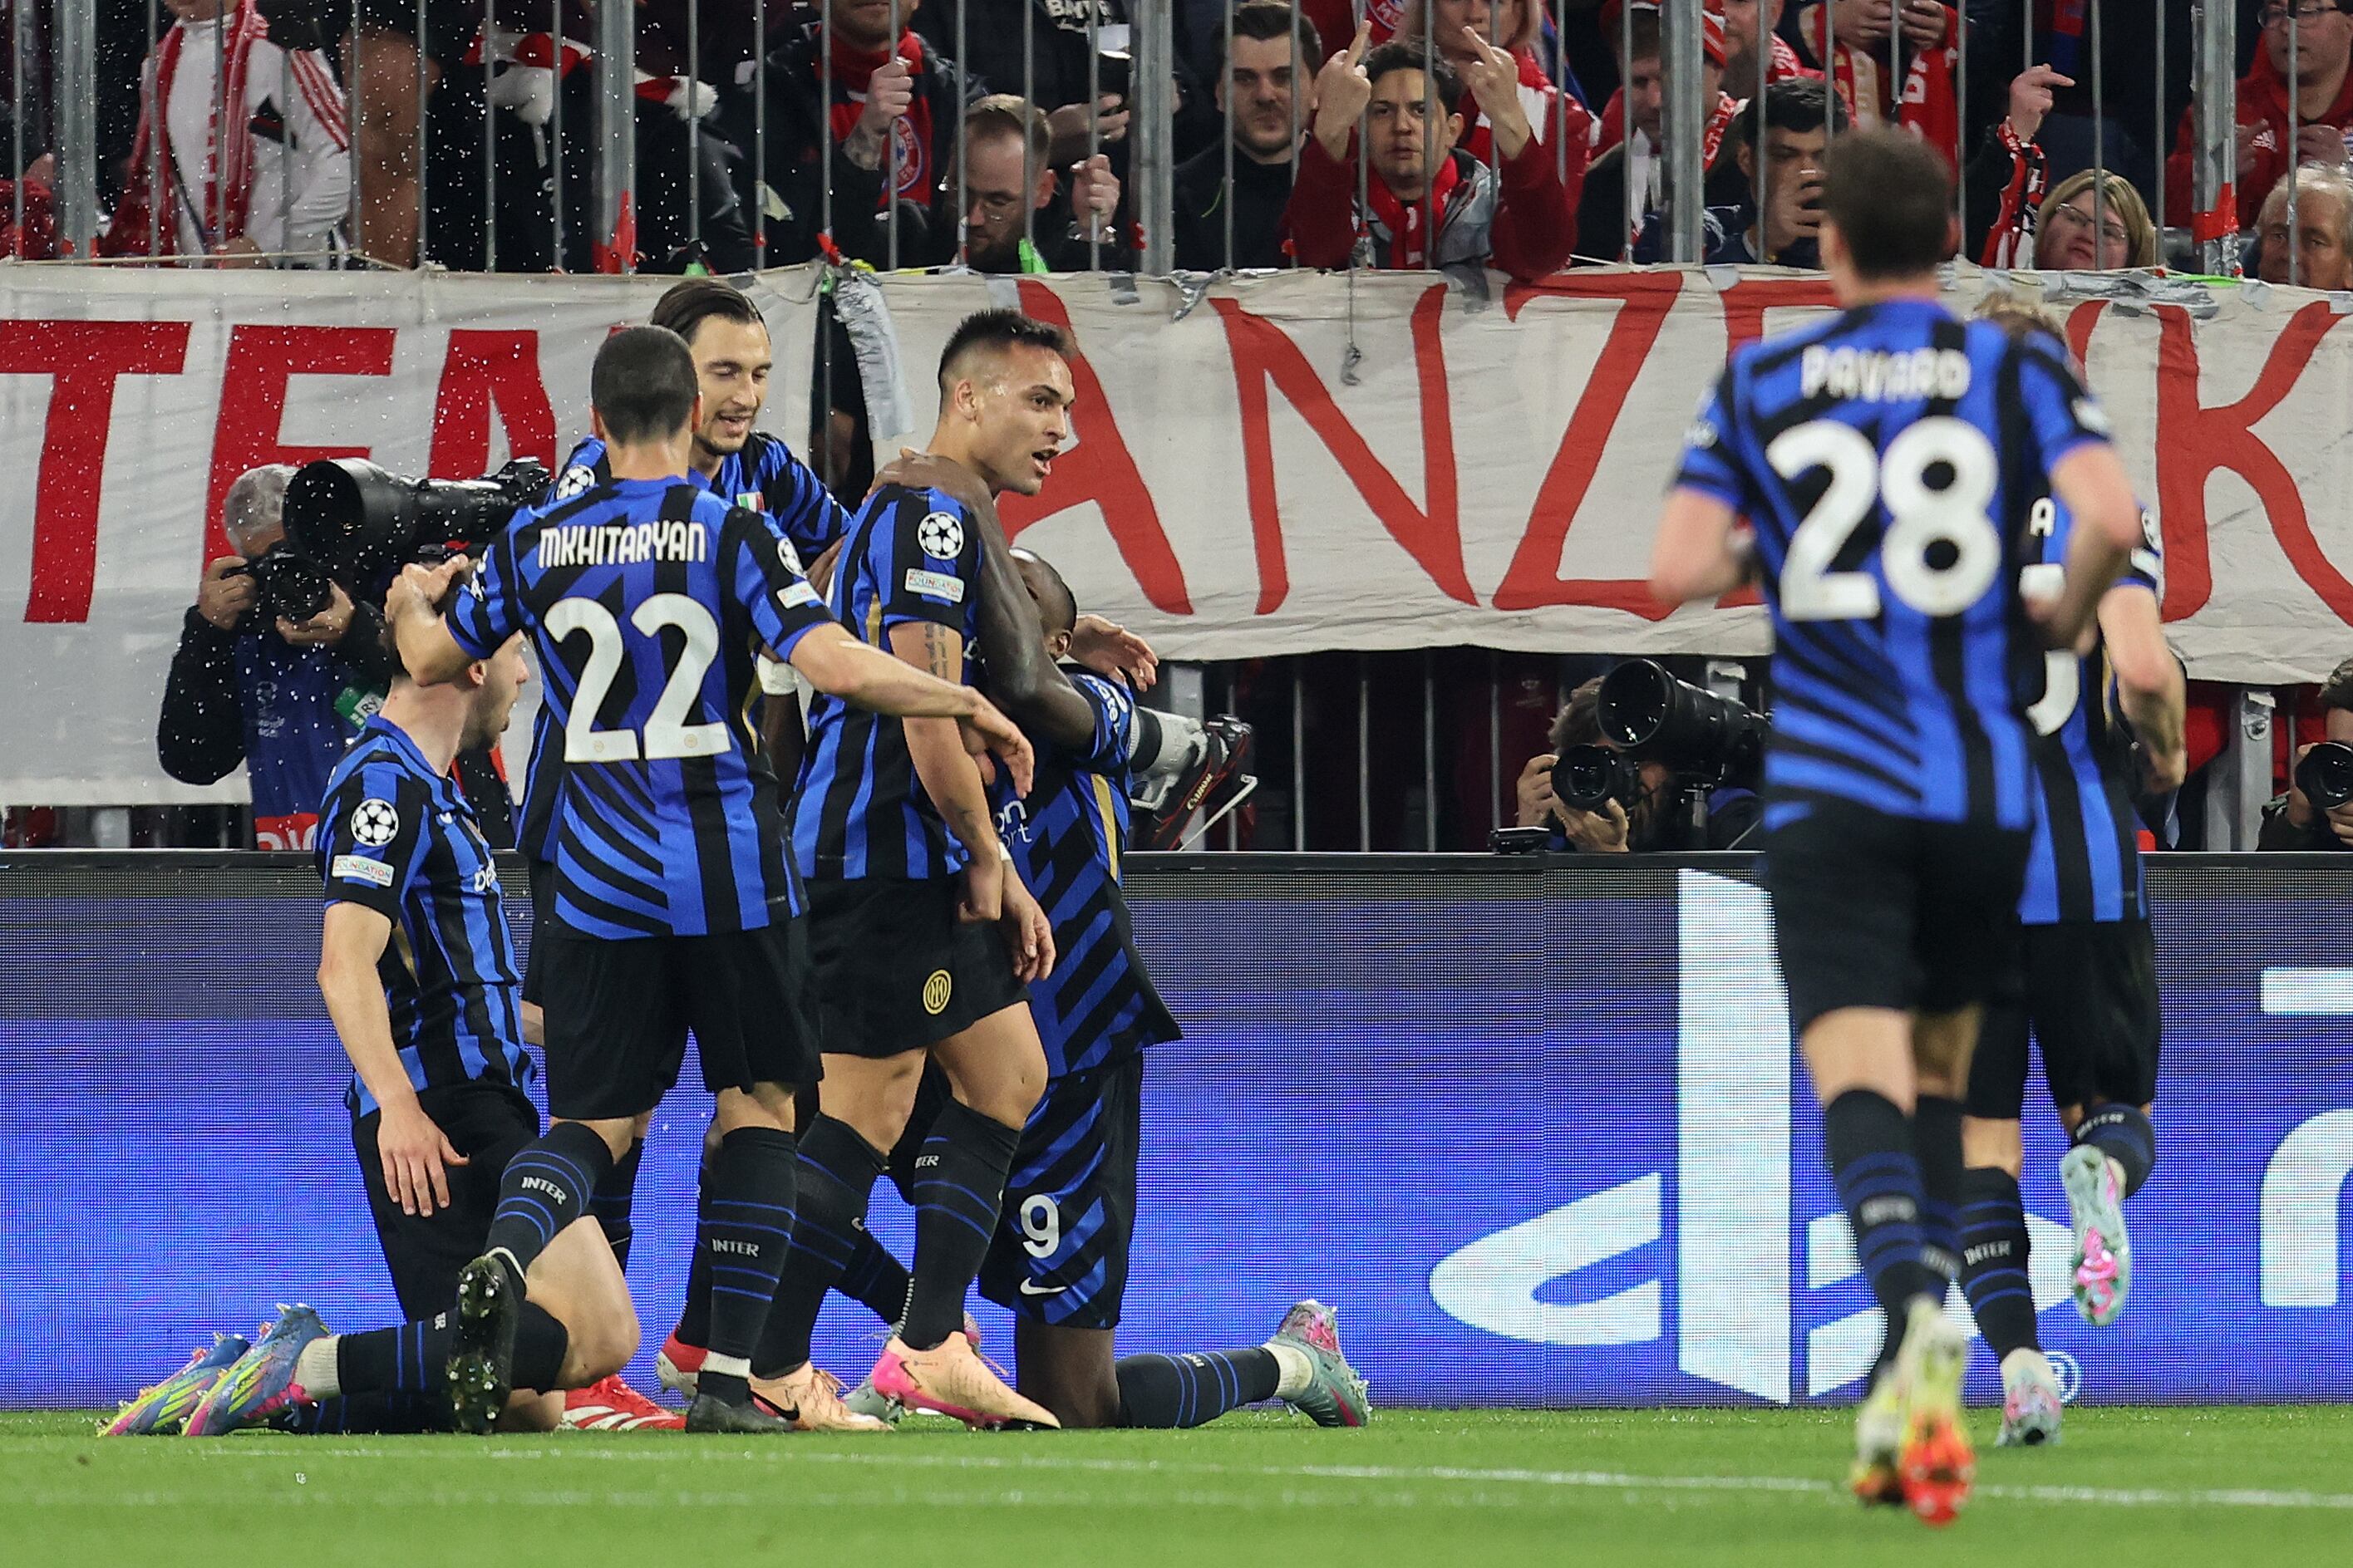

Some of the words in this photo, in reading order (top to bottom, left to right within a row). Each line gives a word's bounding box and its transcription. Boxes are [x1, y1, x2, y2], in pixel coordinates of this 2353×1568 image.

[1800, 345, 1971, 403] PAVARD
[539, 520, 706, 568] MKHITARYAN
[1765, 416, 2000, 620] 28
[544, 592, 731, 763] 22
[522, 1177, 567, 1205] INTER
[711, 1238, 760, 1257] INTER
[1020, 1194, 1060, 1258] 9
